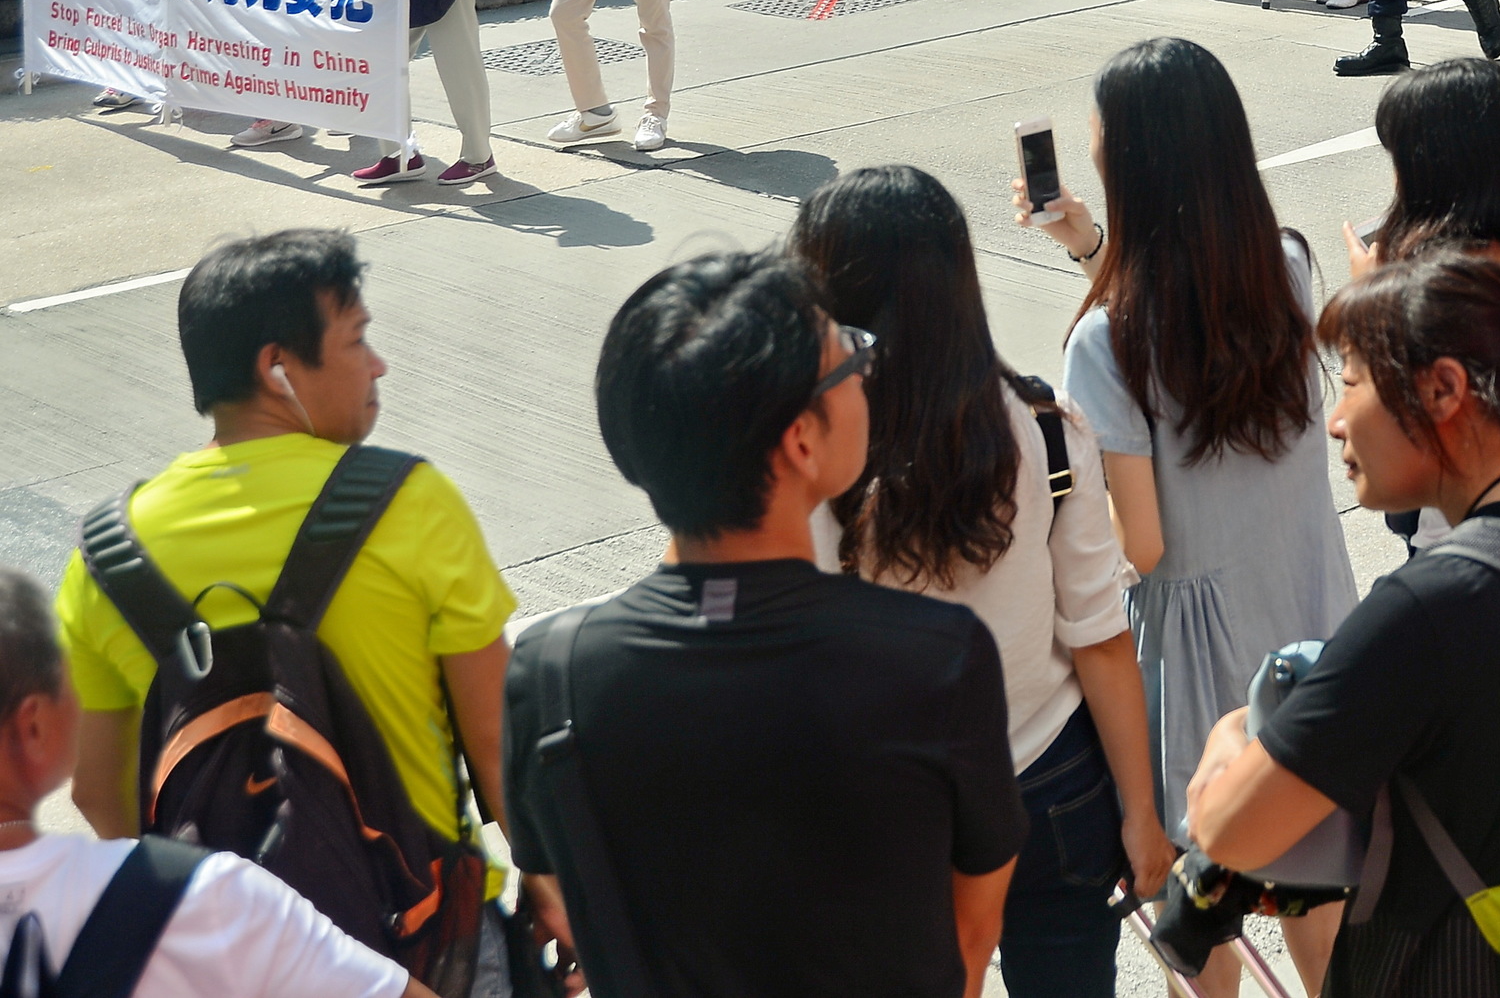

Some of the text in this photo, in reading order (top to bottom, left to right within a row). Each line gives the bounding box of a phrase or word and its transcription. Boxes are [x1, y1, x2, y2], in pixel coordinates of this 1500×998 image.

[48, 30, 80, 56] Bring
[83, 35, 122, 65] Culprits
[124, 48, 132, 64] to
[133, 52, 161, 75] Justice
[181, 63, 219, 87] Crime
[224, 71, 280, 97] Against
[285, 76, 370, 112] Humanity
[51, 2, 370, 74] Stop Forced Live Organ Harvesting in China
